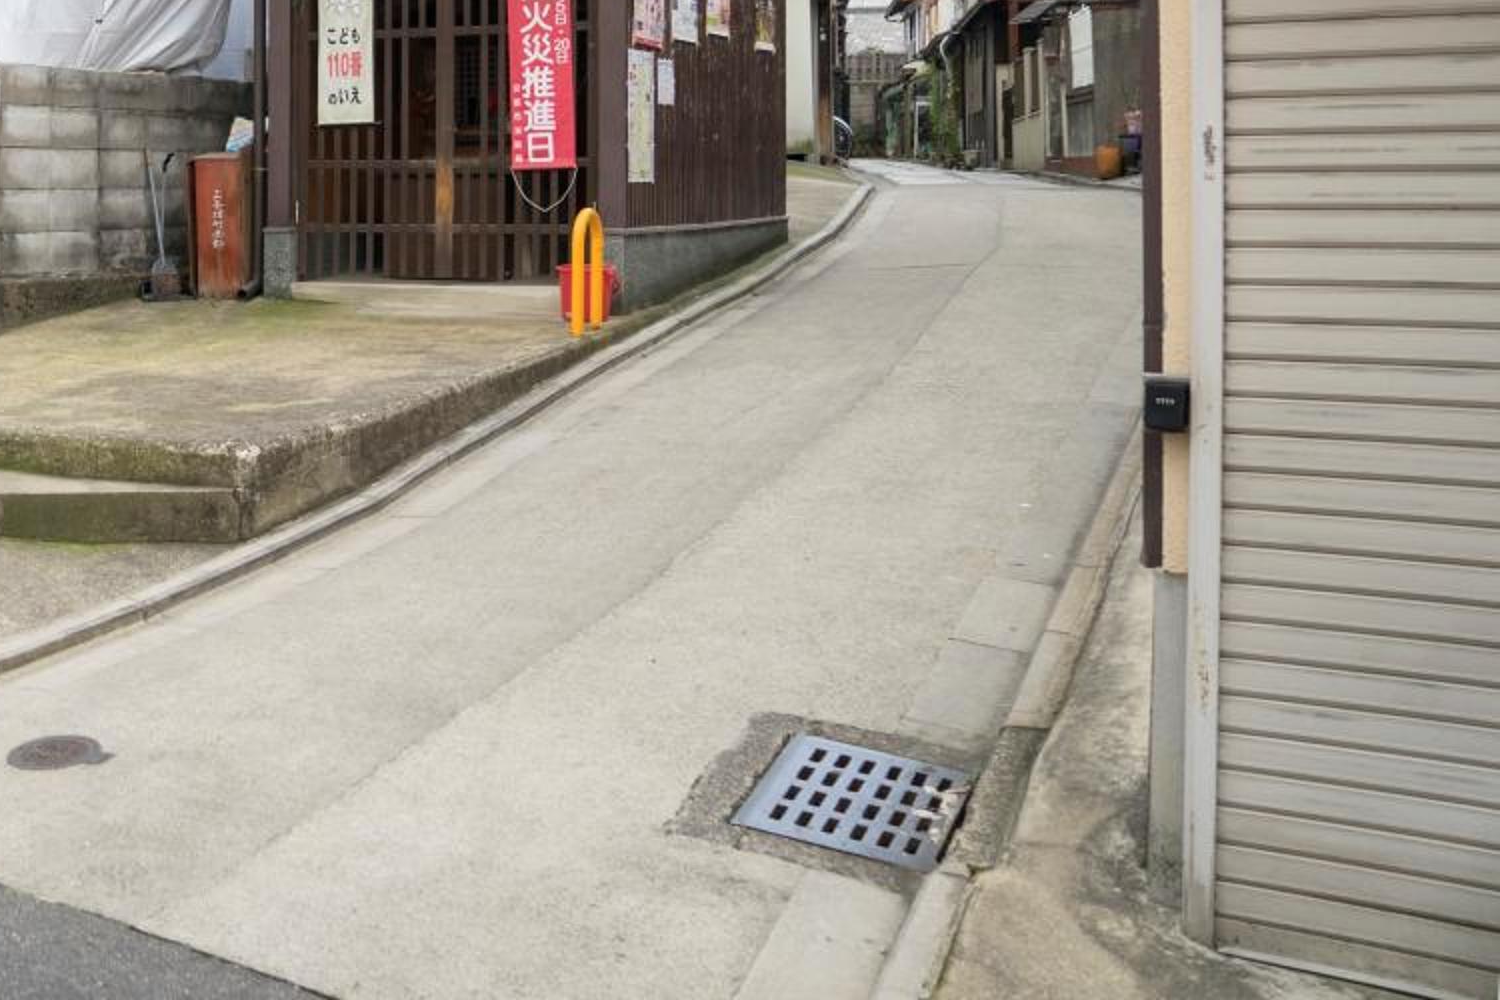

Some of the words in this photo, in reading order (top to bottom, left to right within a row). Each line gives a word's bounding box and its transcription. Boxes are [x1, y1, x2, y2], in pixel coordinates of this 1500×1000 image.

[327, 26, 361, 45] こども
[327, 51, 362, 77] 110番
[328, 86, 362, 105] のいえ
